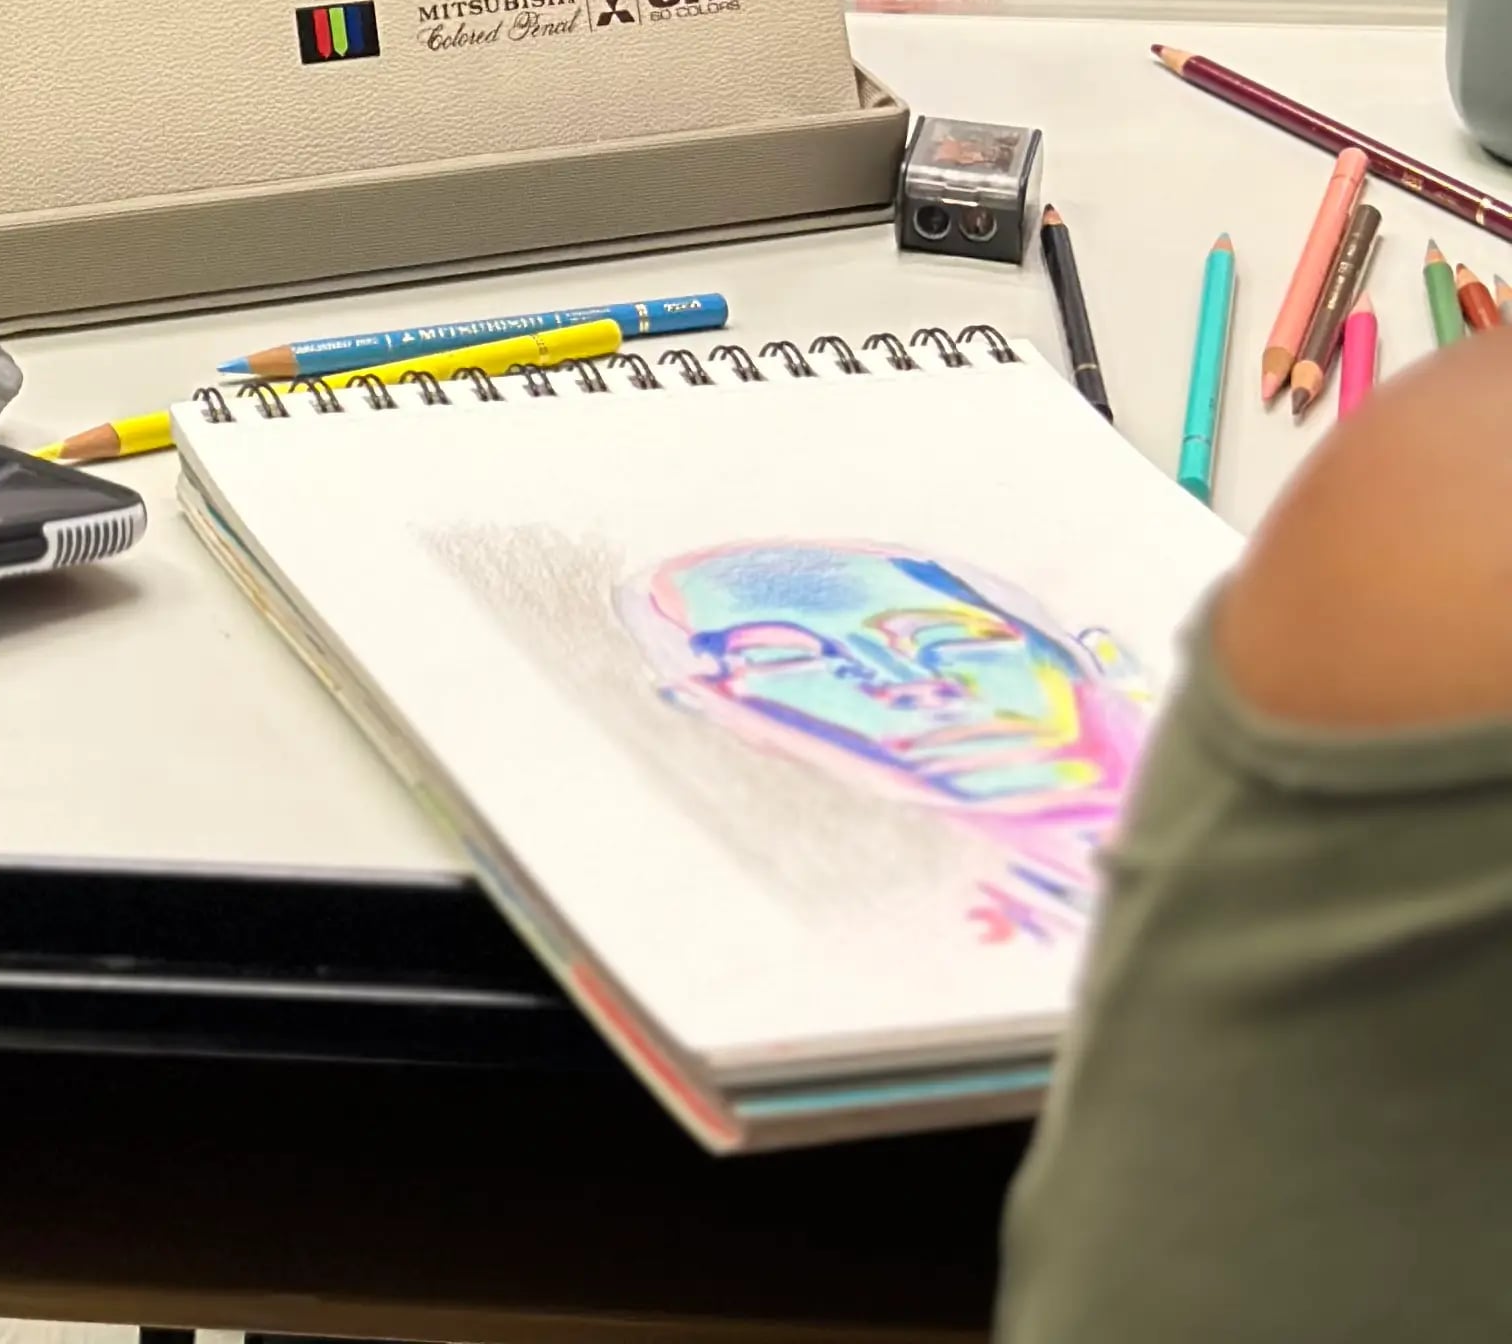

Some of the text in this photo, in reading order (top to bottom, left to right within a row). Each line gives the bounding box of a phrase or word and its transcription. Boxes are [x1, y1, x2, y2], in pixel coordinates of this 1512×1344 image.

[650, 0, 741, 22] 60 COLORS
[417, 6, 582, 51] Colored Pencil
